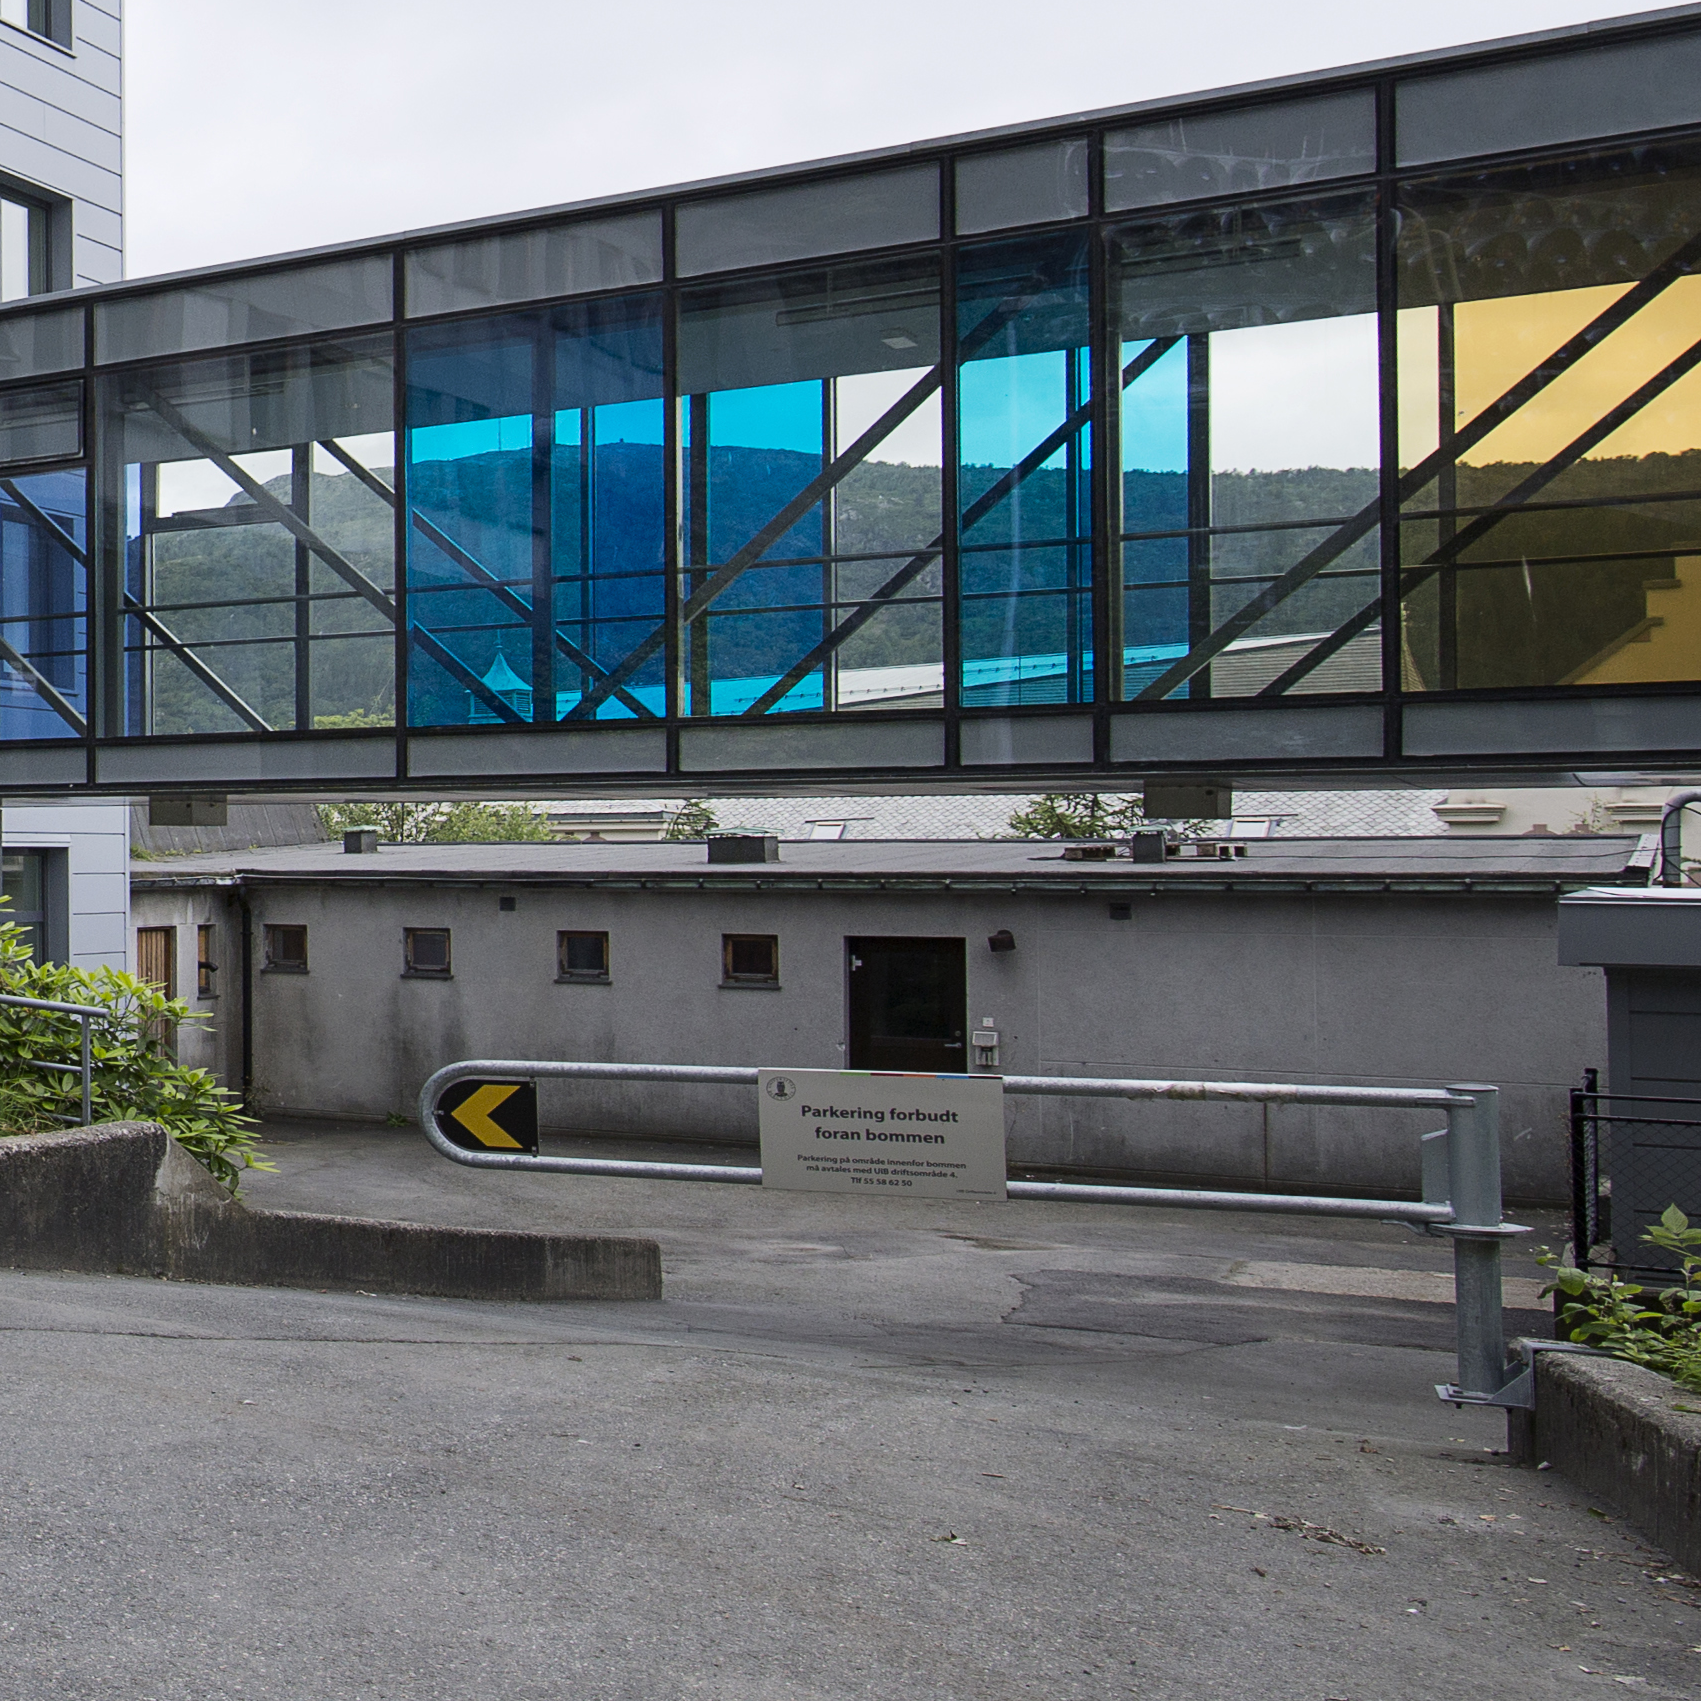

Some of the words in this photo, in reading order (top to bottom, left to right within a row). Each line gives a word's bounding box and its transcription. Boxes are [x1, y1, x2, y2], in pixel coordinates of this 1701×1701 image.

[801, 1105, 885, 1123] Parkering
[889, 1108, 959, 1123] forbudt
[815, 1127, 861, 1141] foran
[865, 1129, 945, 1144] bommen
[797, 1154, 838, 1164] Parkering
[839, 1156, 851, 1165] på
[852, 1157, 885, 1166] område
[887, 1158, 924, 1167] innenfor
[926, 1160, 967, 1169] bommen
[821, 1165, 851, 1173] avtales
[853, 1166, 873, 1174] med
[874, 1167, 889, 1175] UiB
[890, 1168, 948, 1178] driftsområde
[949, 1171, 958, 1179] 4.
[850, 1176, 862, 1184] Tlf
[863, 1177, 874, 1185] 55
[875, 1178, 887, 1186] 58
[901, 1179, 913, 1187] 50
